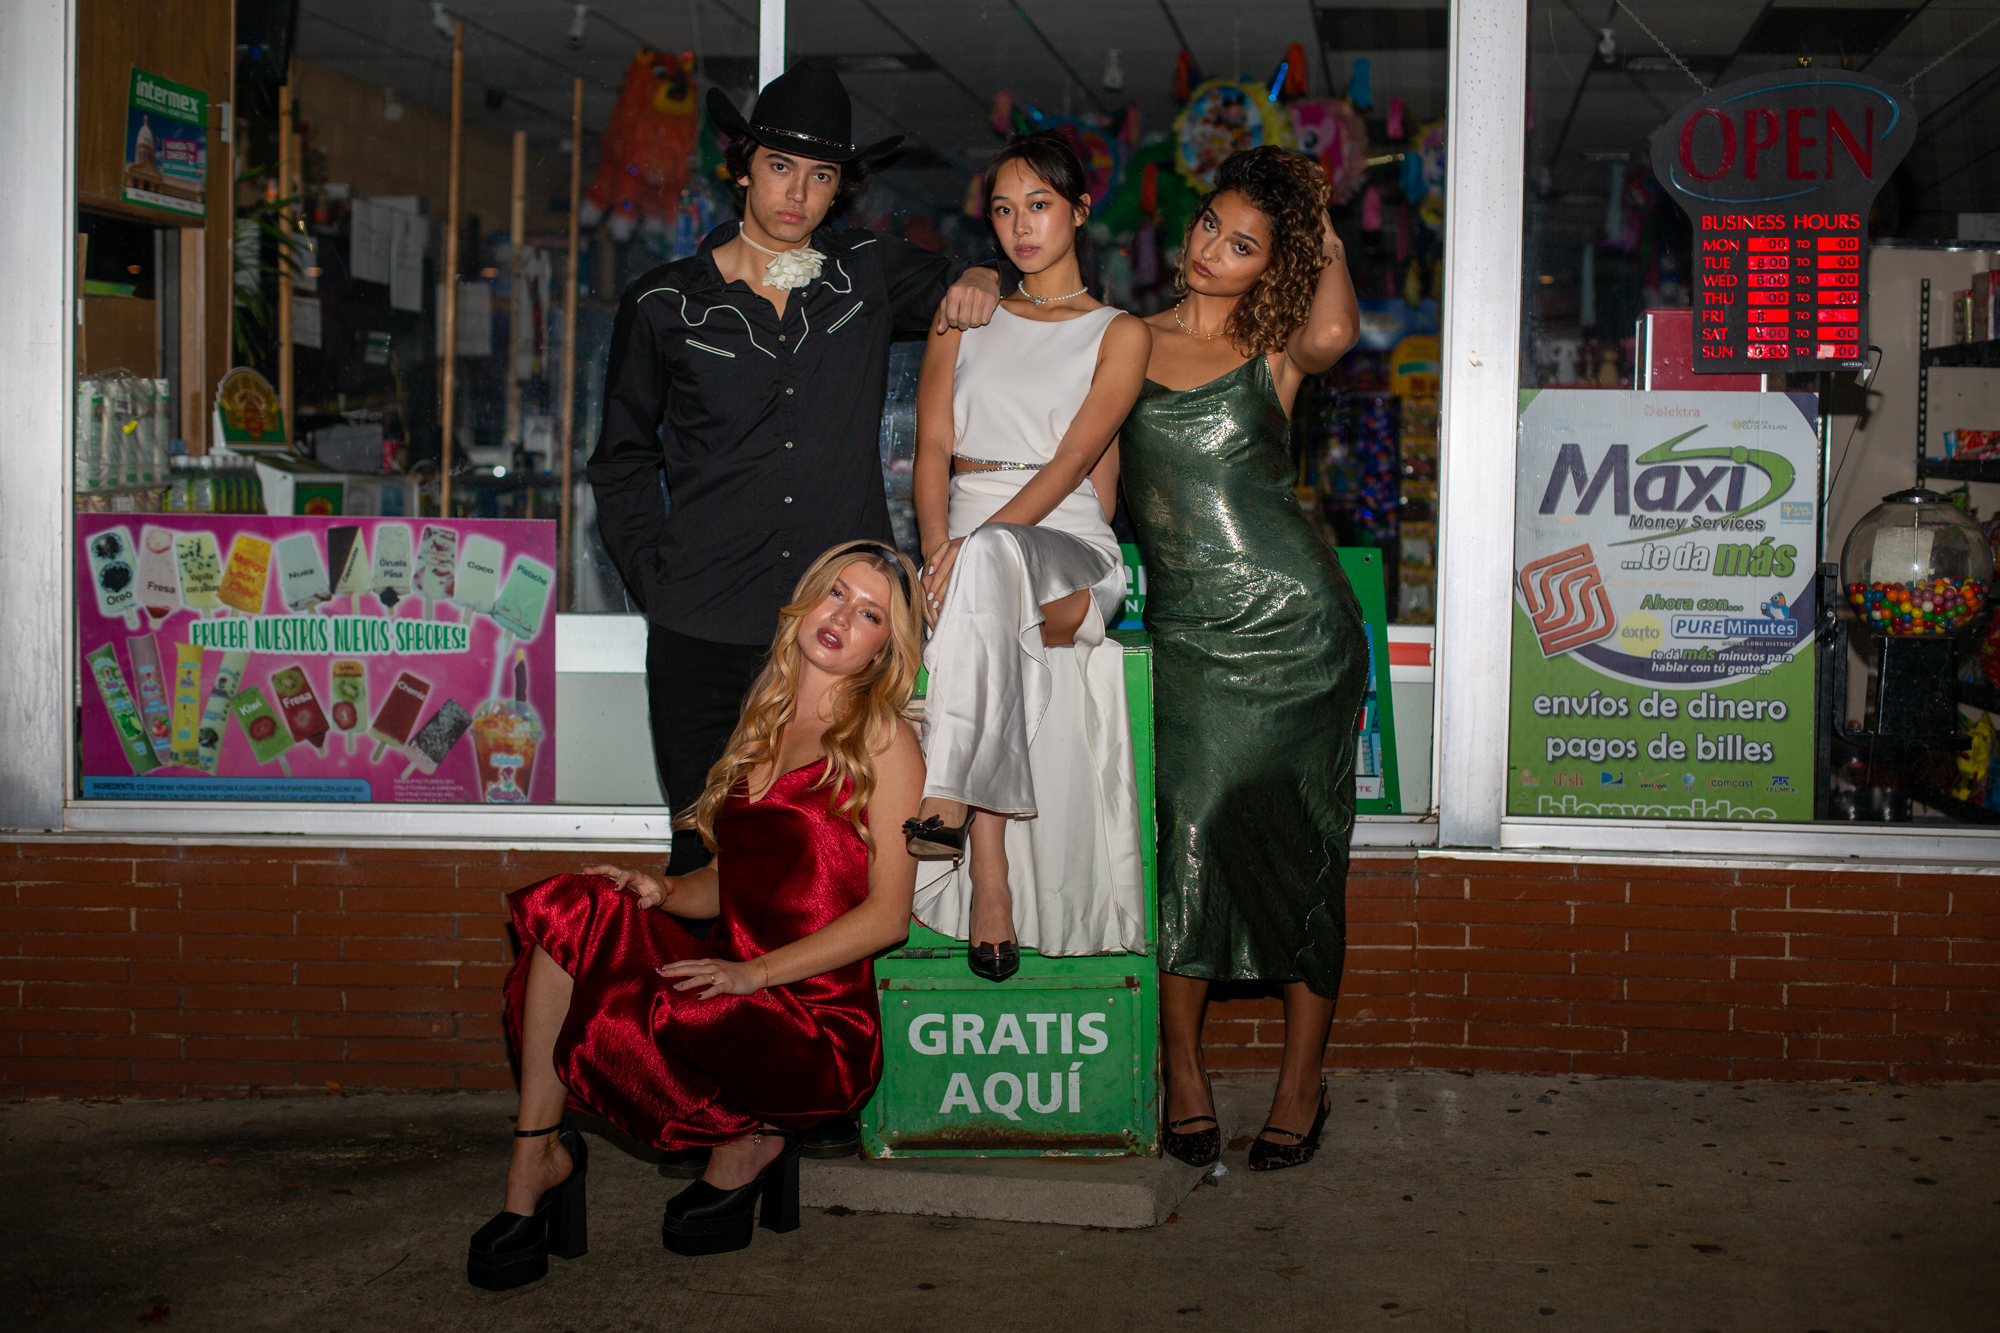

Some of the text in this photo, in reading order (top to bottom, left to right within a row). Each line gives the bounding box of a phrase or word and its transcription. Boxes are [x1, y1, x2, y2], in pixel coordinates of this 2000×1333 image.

[136, 74, 199, 114] intermex
[1679, 107, 1874, 182] OPEN
[1702, 213, 1861, 230] BUSINESS HOURS
[1703, 239, 1740, 251] MON
[1795, 240, 1811, 249] TO
[1703, 257, 1731, 269] TUE
[1757, 257, 1787, 268] 8:00
[1795, 257, 1811, 266] TO
[1703, 275, 1738, 287] WED
[1757, 275, 1786, 285] 8:00
[1795, 275, 1811, 285] TO
[1703, 292, 1735, 305] THU
[1795, 293, 1811, 303] TO
[1702, 310, 1724, 322] FRI
[1795, 311, 1811, 320] TO
[1702, 328, 1728, 340] SAT
[1795, 329, 1811, 338] TO
[1702, 346, 1734, 358] SUN
[1795, 346, 1811, 356] TO
[1656, 405, 1701, 418] elektra
[1538, 443, 1750, 515] Maxi
[1628, 515, 1766, 532] Money Services
[232, 552, 267, 574] Mango
[379, 559, 407, 568] Ciruela
[1672, 542, 1710, 571] da
[1713, 537, 1798, 577] más
[289, 568, 315, 580] Nuez
[467, 561, 494, 574] Coco
[517, 564, 548, 585] Pistache
[236, 572, 255, 584] con
[147, 581, 176, 594] Fresa
[186, 585, 198, 593] con
[229, 581, 255, 598] Chile
[106, 591, 133, 605] Oreo
[1640, 594, 1744, 612] Ahora con...
[192, 618, 467, 652] PRUEBA NUESTROS NUEVOS SABORES!
[1621, 626, 1661, 642] éxito
[1675, 619, 1796, 636] PURE Minutes
[1651, 650, 1664, 660] te
[1682, 646, 1716, 661] más
[1718, 650, 1765, 662] minutos
[1767, 653, 1794, 664] para
[1651, 662, 1771, 675] hablar con tú gente...
[238, 698, 263, 717] Kiwi
[282, 691, 313, 709] Fresa
[1533, 690, 1788, 721] envíos de dinero
[1546, 732, 1774, 763] pagos de billes
[1553, 772, 1585, 787] dish
[1640, 782, 1667, 790] verizon
[1710, 779, 1753, 788] comcast
[908, 1012, 1109, 1056] GRATIS
[938, 1061, 1084, 1121] AQUÍ
